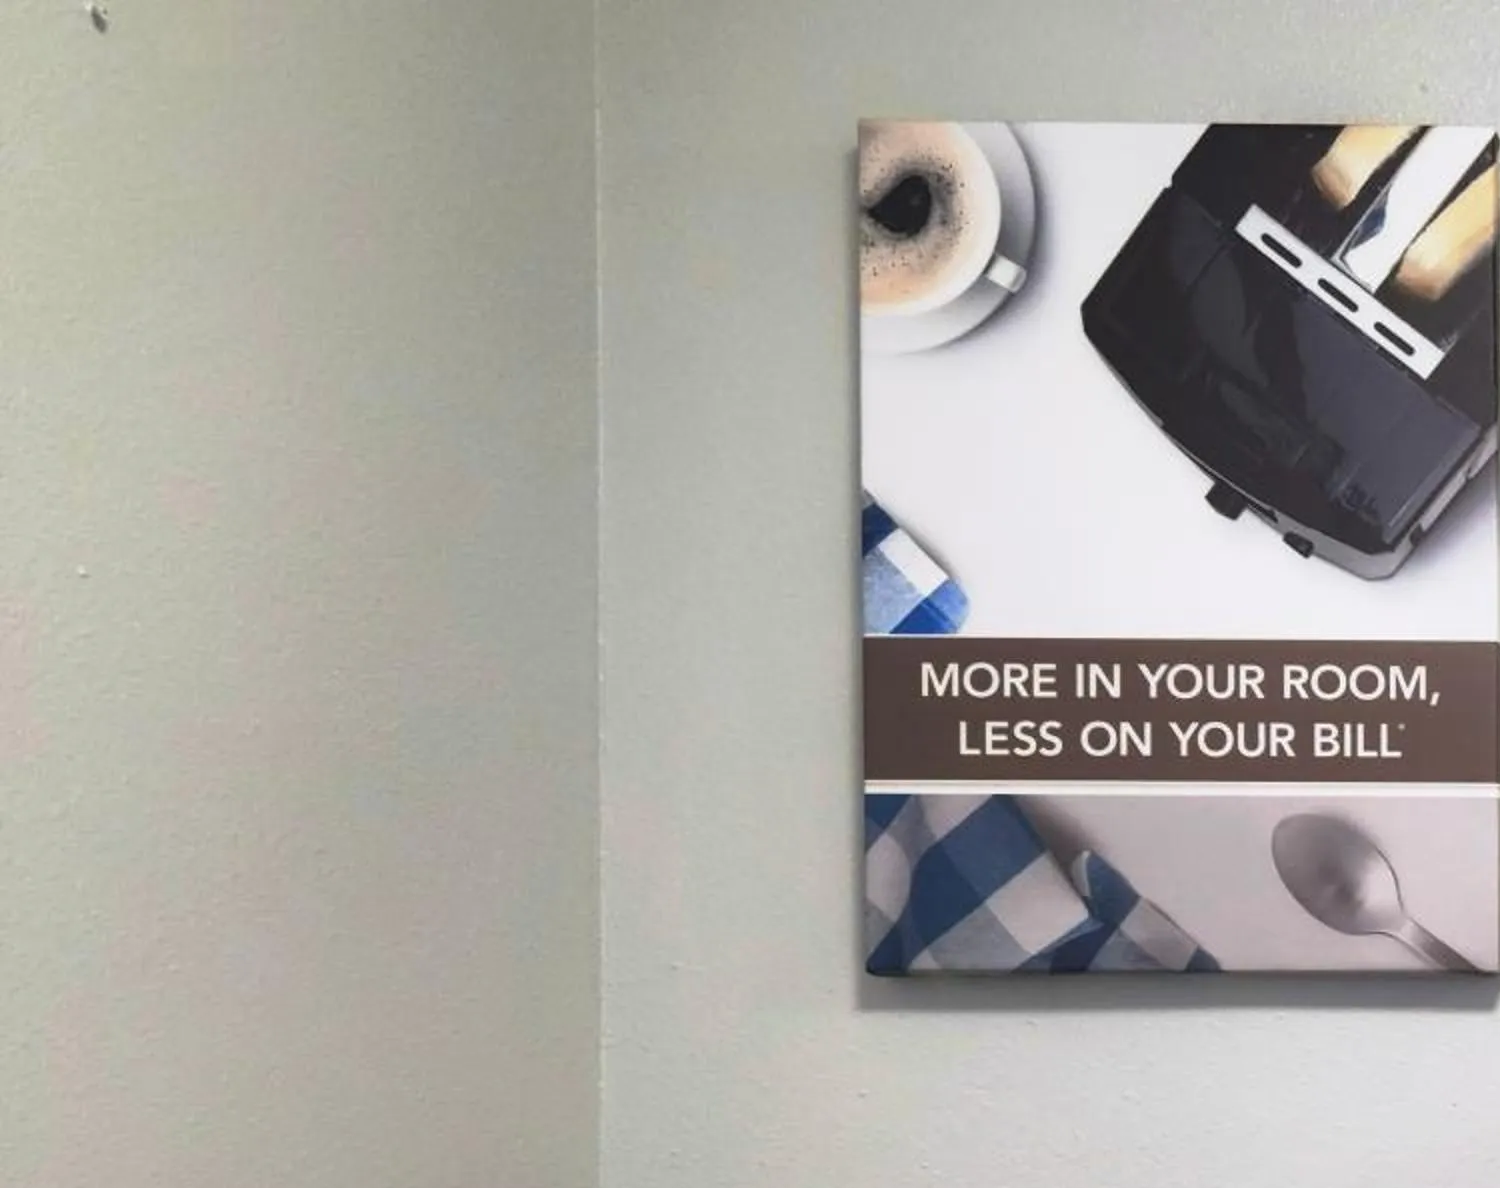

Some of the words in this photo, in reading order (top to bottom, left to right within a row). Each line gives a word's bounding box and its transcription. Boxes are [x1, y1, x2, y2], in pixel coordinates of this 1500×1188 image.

[920, 661, 1057, 699] MORE
[1076, 663, 1122, 699] IN
[1137, 663, 1265, 700] YOUR
[1283, 663, 1440, 706] ROOM,
[959, 720, 1063, 757] LESS
[1080, 720, 1152, 757] ON
[1168, 721, 1296, 758] YOUR
[1313, 722, 1402, 758] BILL
